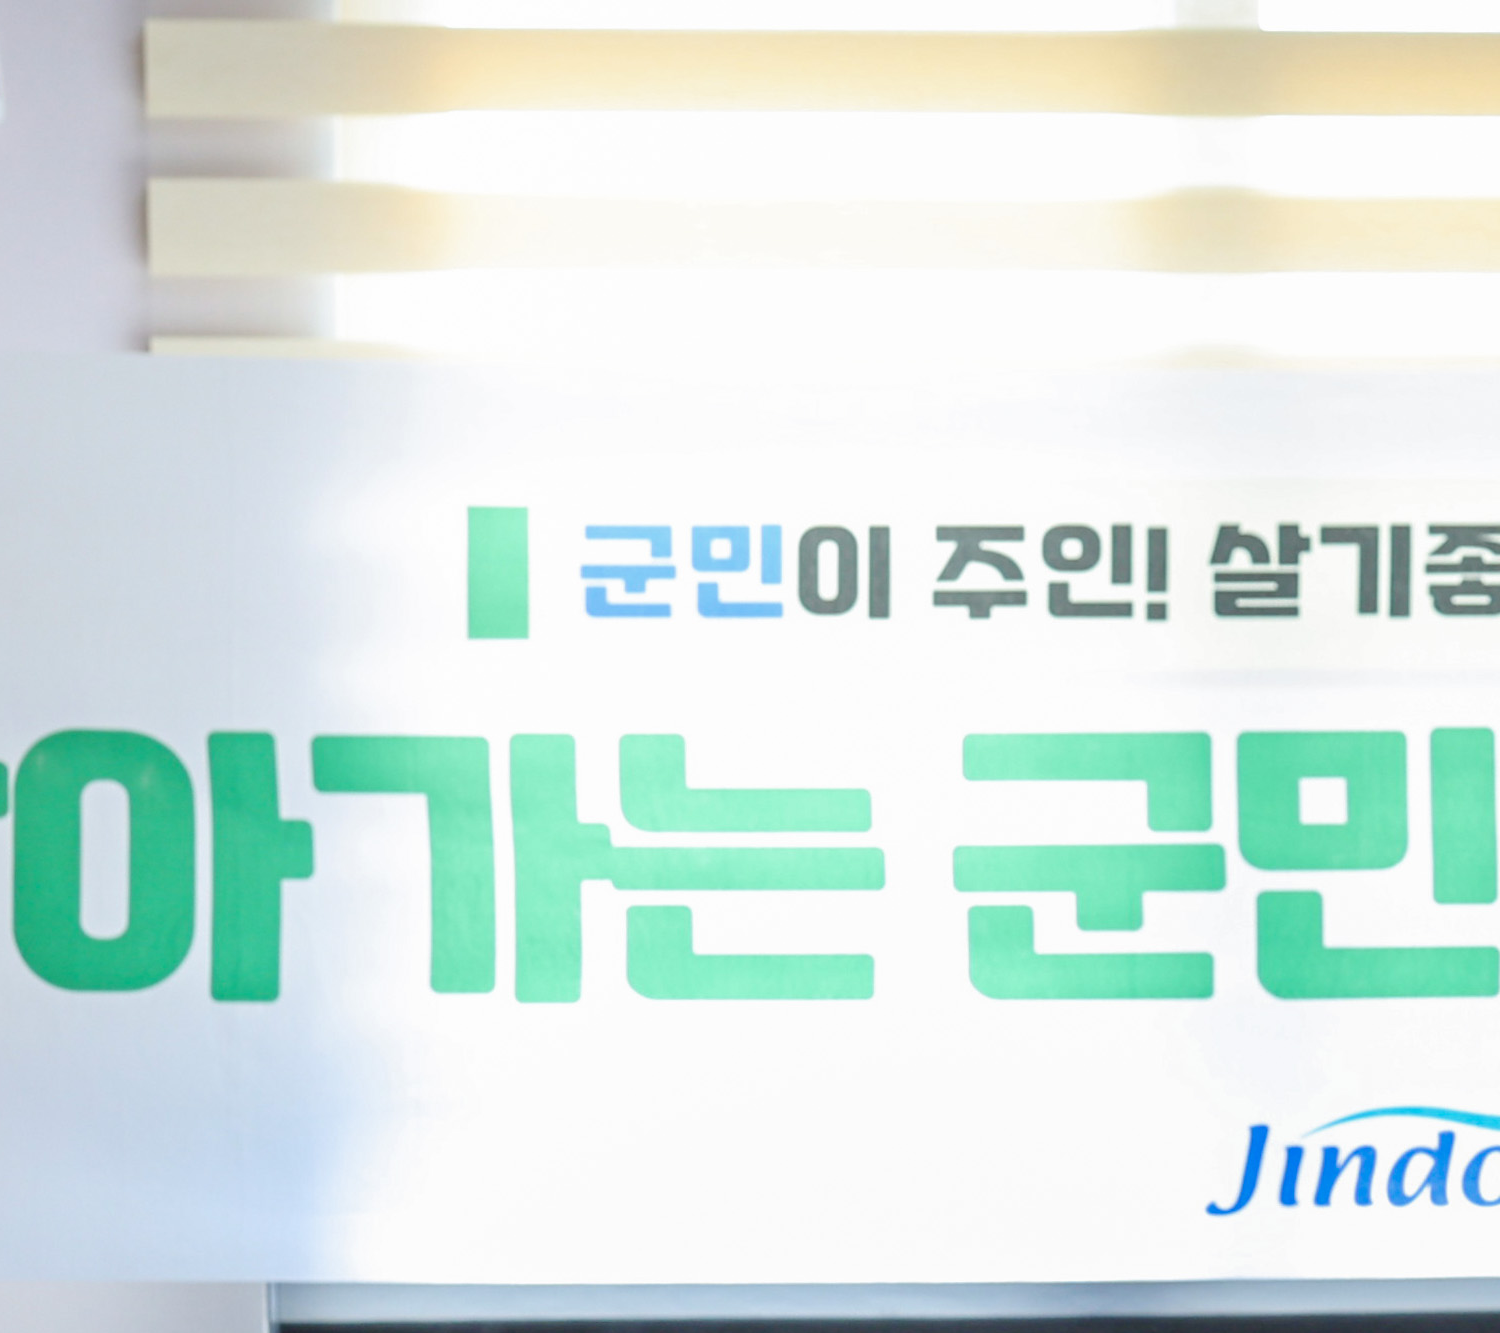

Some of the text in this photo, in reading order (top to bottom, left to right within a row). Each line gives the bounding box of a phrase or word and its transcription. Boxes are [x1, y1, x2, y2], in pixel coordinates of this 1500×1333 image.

[581, 523, 891, 620] 군민이
[932, 523, 1168, 621] 주인!
[953, 727, 1500, 1000] 군민
